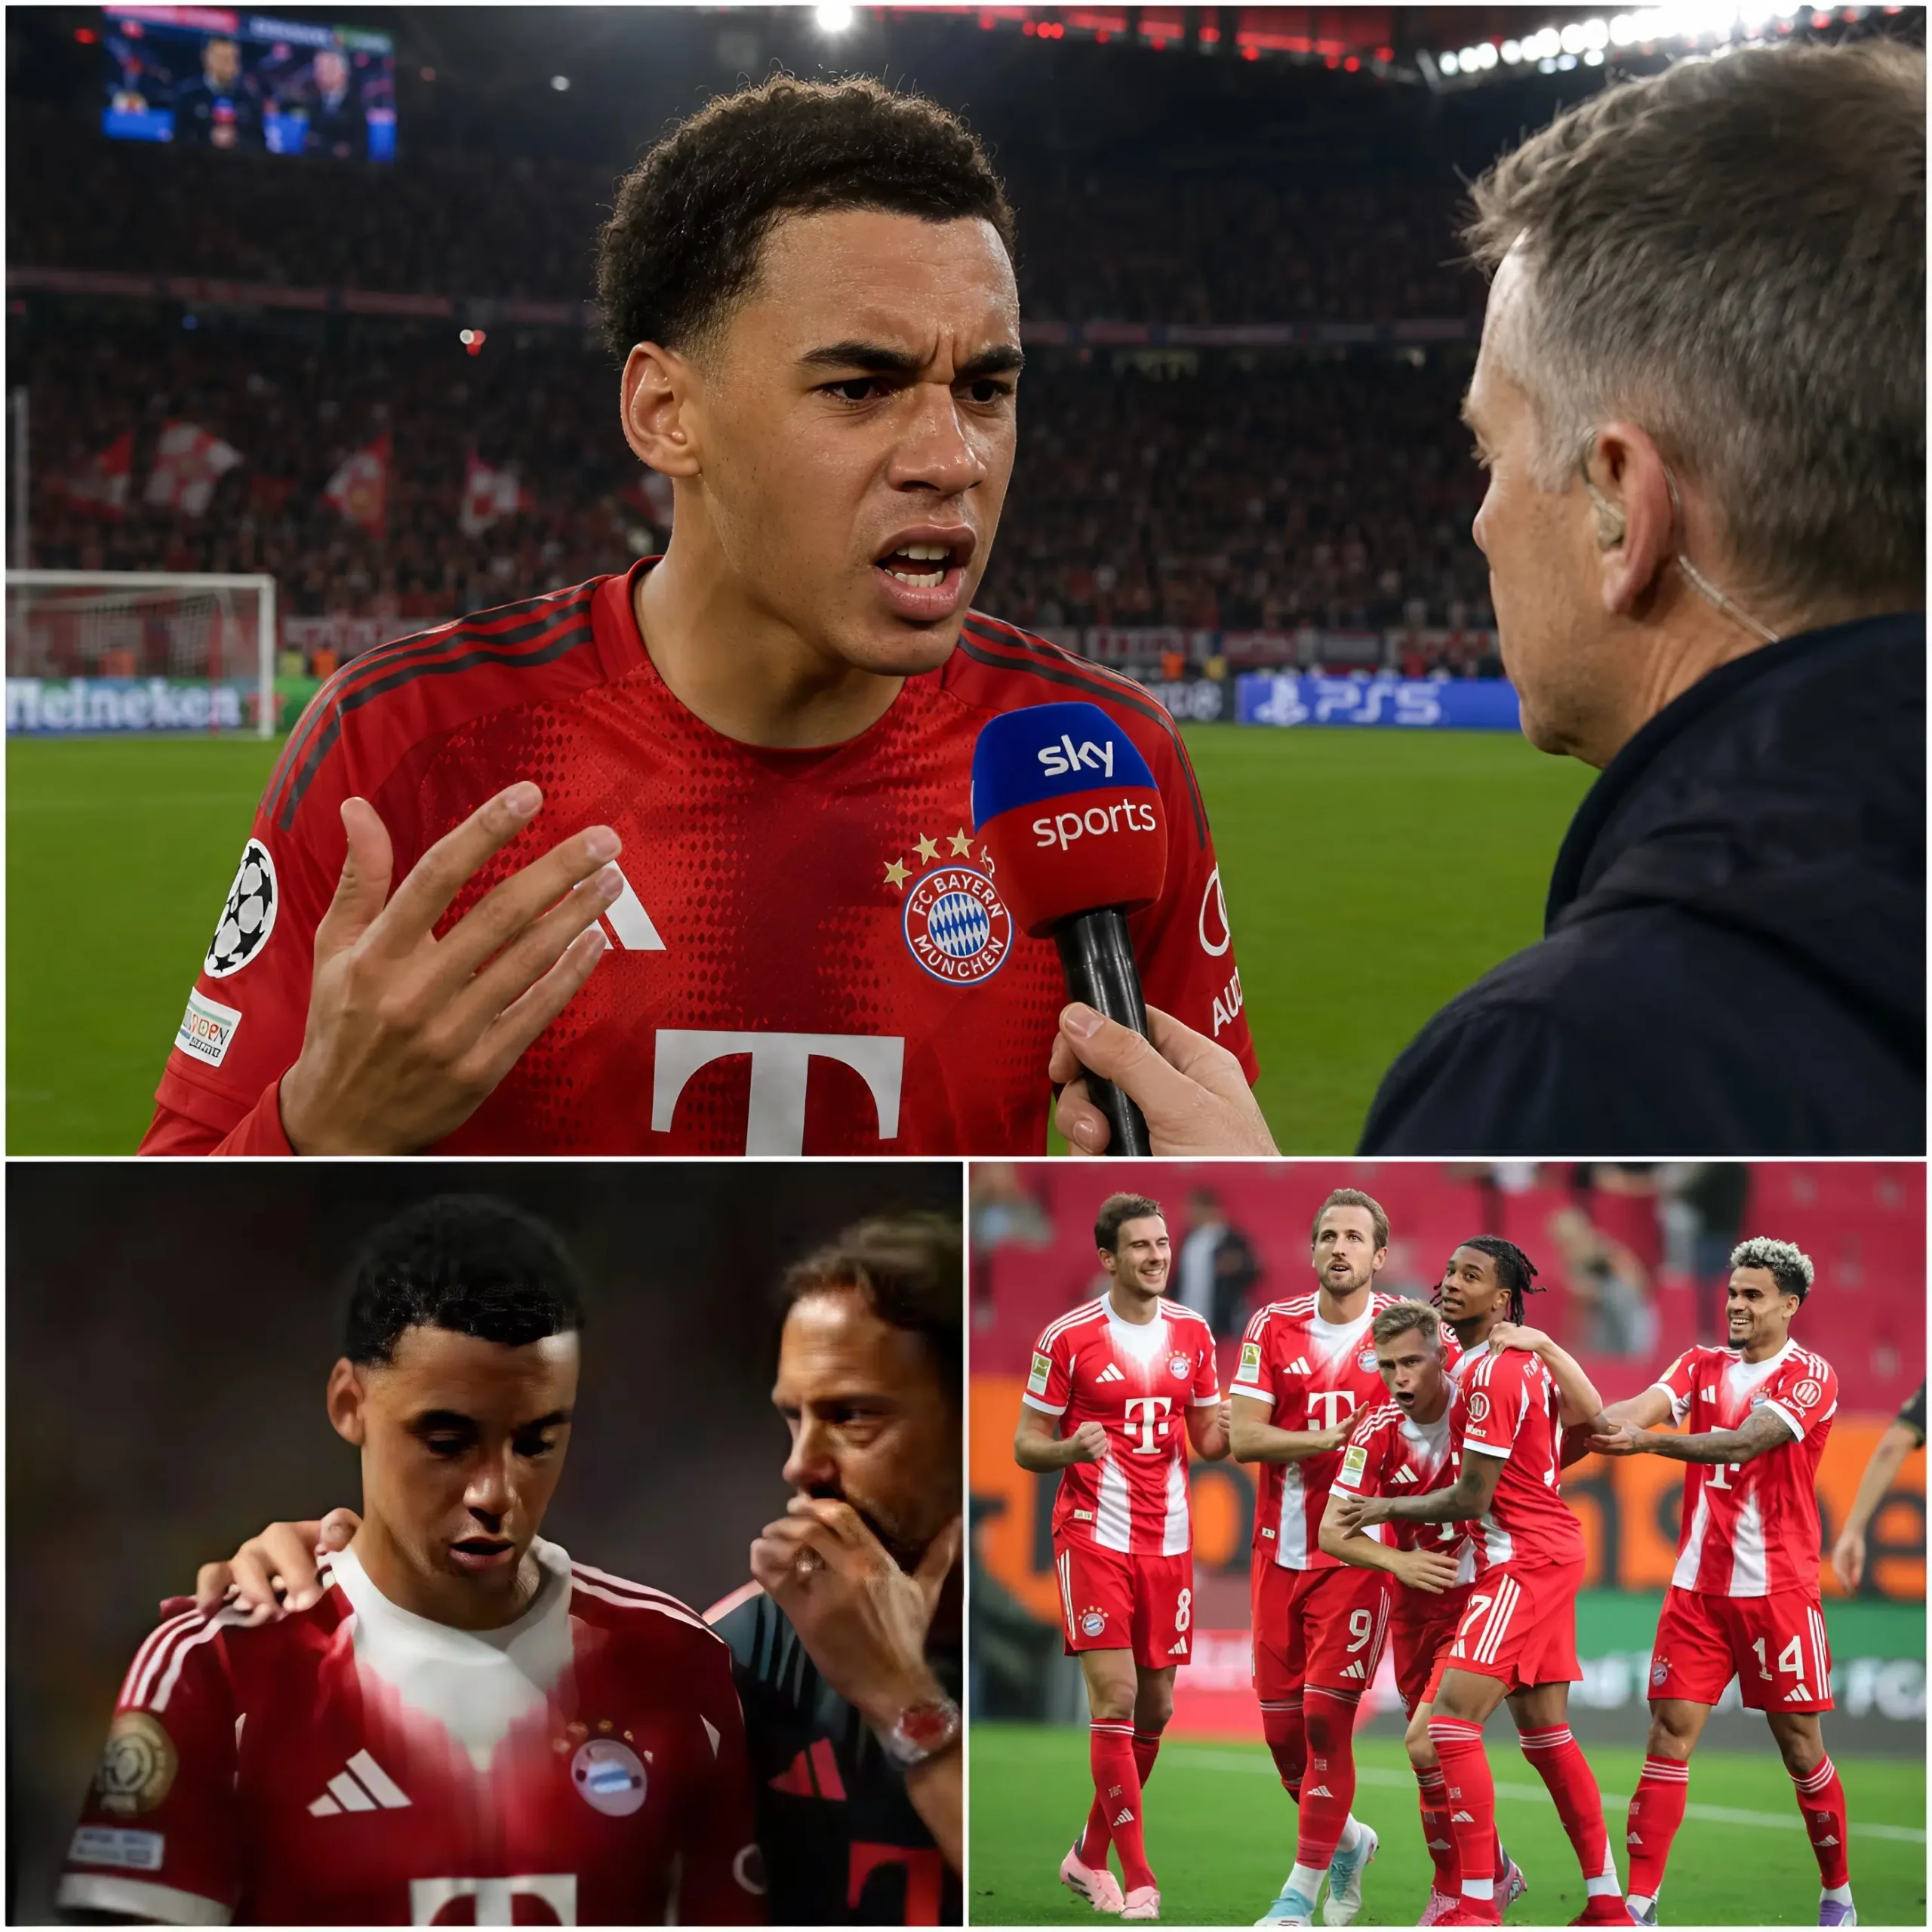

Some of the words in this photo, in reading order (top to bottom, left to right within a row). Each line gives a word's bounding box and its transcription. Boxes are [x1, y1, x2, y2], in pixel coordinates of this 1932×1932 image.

[1315, 681, 1441, 725] PS5
[1038, 734, 1113, 777] sky
[1032, 798, 1156, 851] sports
[912, 890, 933, 916] FC
[934, 874, 1004, 918] BAYERN
[1124, 1397, 1173, 1454] T
[1174, 1588, 1191, 1632] 8
[1347, 1609, 1372, 1653] 9
[1752, 1635, 1804, 1681] 14
